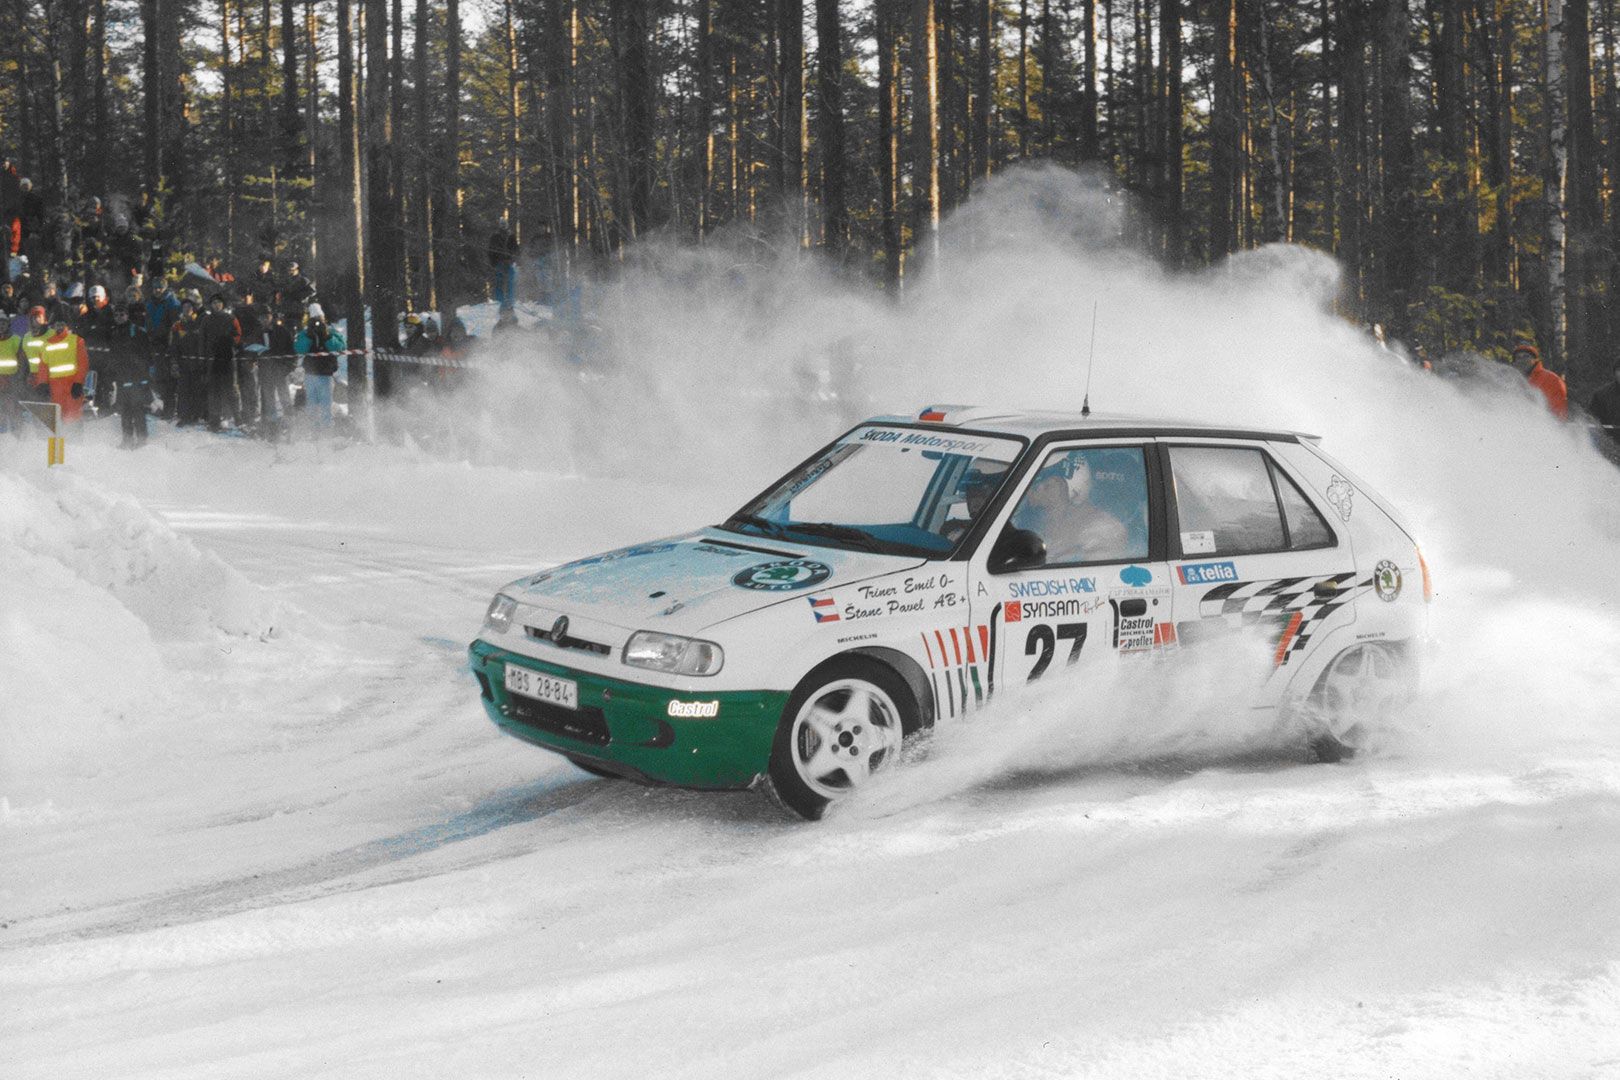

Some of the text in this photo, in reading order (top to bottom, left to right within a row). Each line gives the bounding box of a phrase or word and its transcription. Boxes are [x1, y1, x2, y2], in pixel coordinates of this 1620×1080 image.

[904, 433, 990, 452] Motorsport
[1201, 565, 1234, 581] telia
[858, 586, 897, 599] Triner
[904, 577, 934, 593] Emil
[977, 581, 988, 596] A
[1009, 579, 1068, 598] SWEDISH
[887, 599, 924, 614] Pavel
[1023, 599, 1080, 618] SYNSAM
[1120, 617, 1154, 630] Castrol
[837, 633, 877, 643] MICHELIN
[1024, 623, 1088, 685] 27
[537, 677, 568, 704] 28-84
[668, 700, 719, 717] Castrol
